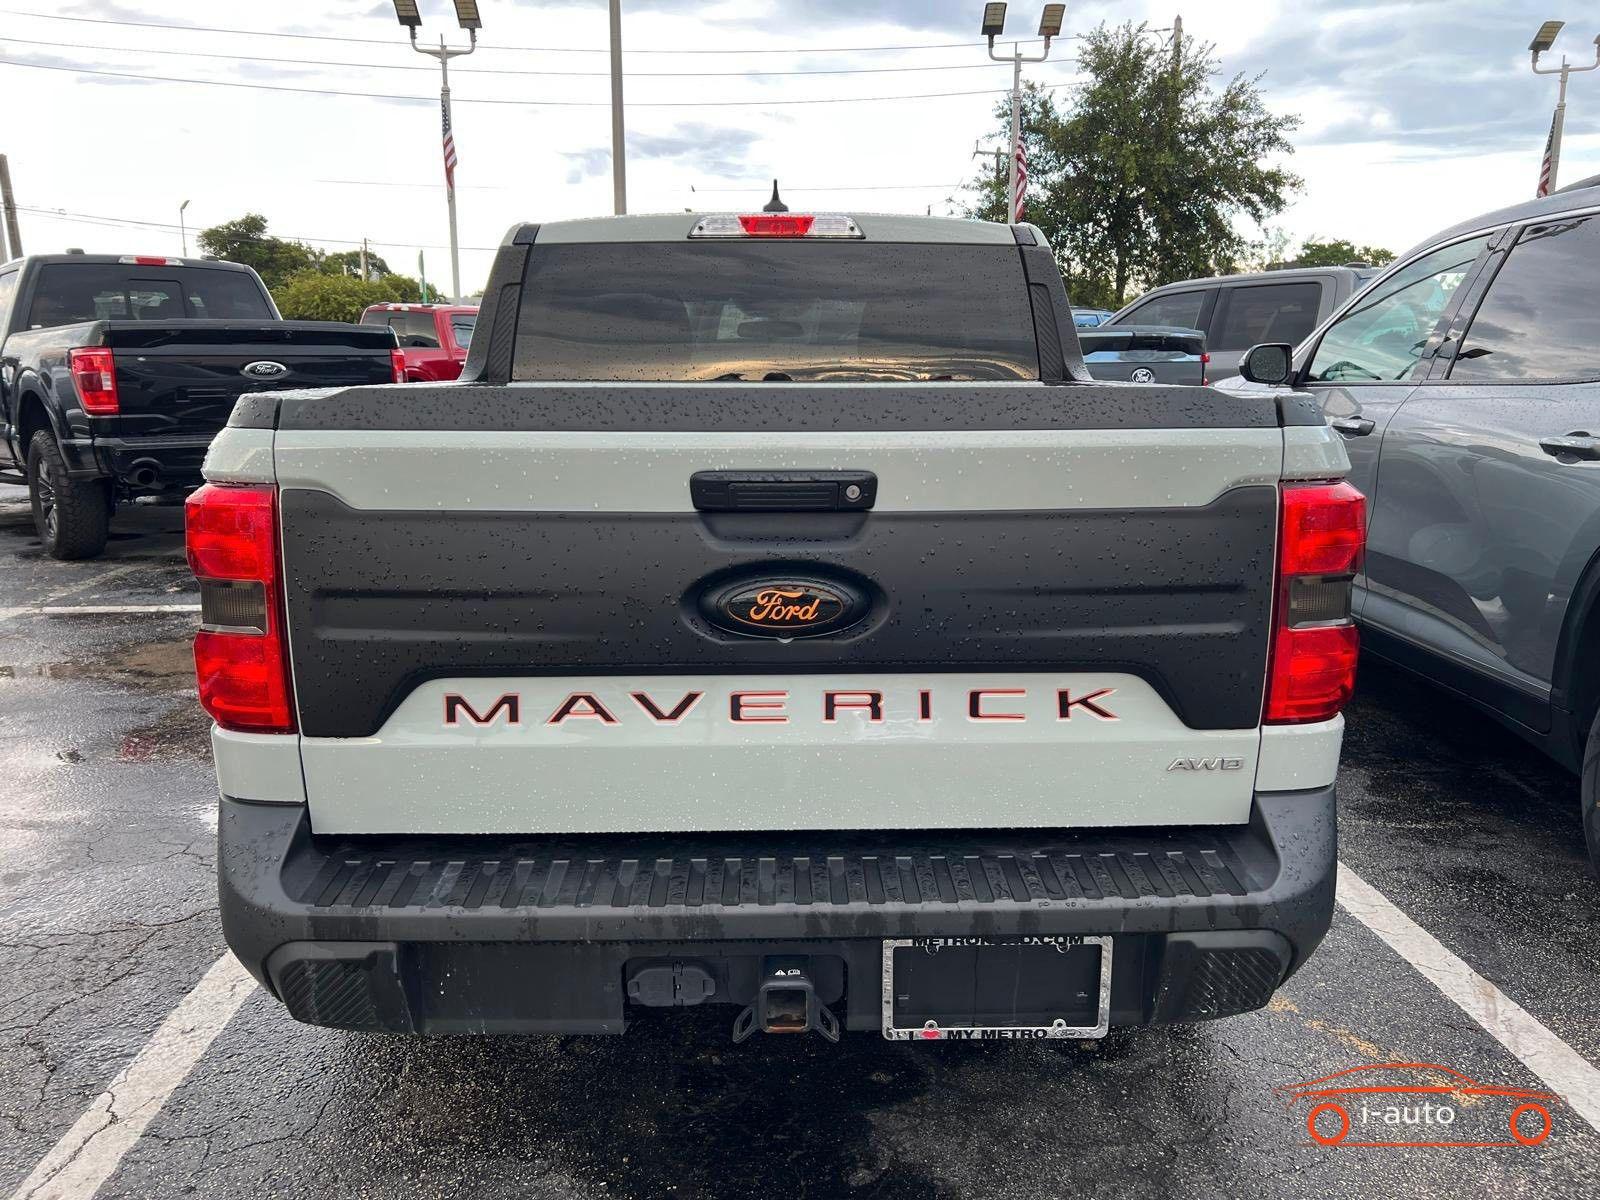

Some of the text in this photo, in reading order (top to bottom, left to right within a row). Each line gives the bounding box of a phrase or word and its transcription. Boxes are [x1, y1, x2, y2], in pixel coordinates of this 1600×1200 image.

[255, 364, 277, 374] Ford
[750, 590, 820, 620] Ford
[443, 688, 1120, 727] MAVERICK
[947, 1029, 975, 1040] MY
[981, 1029, 1048, 1040] METRO
